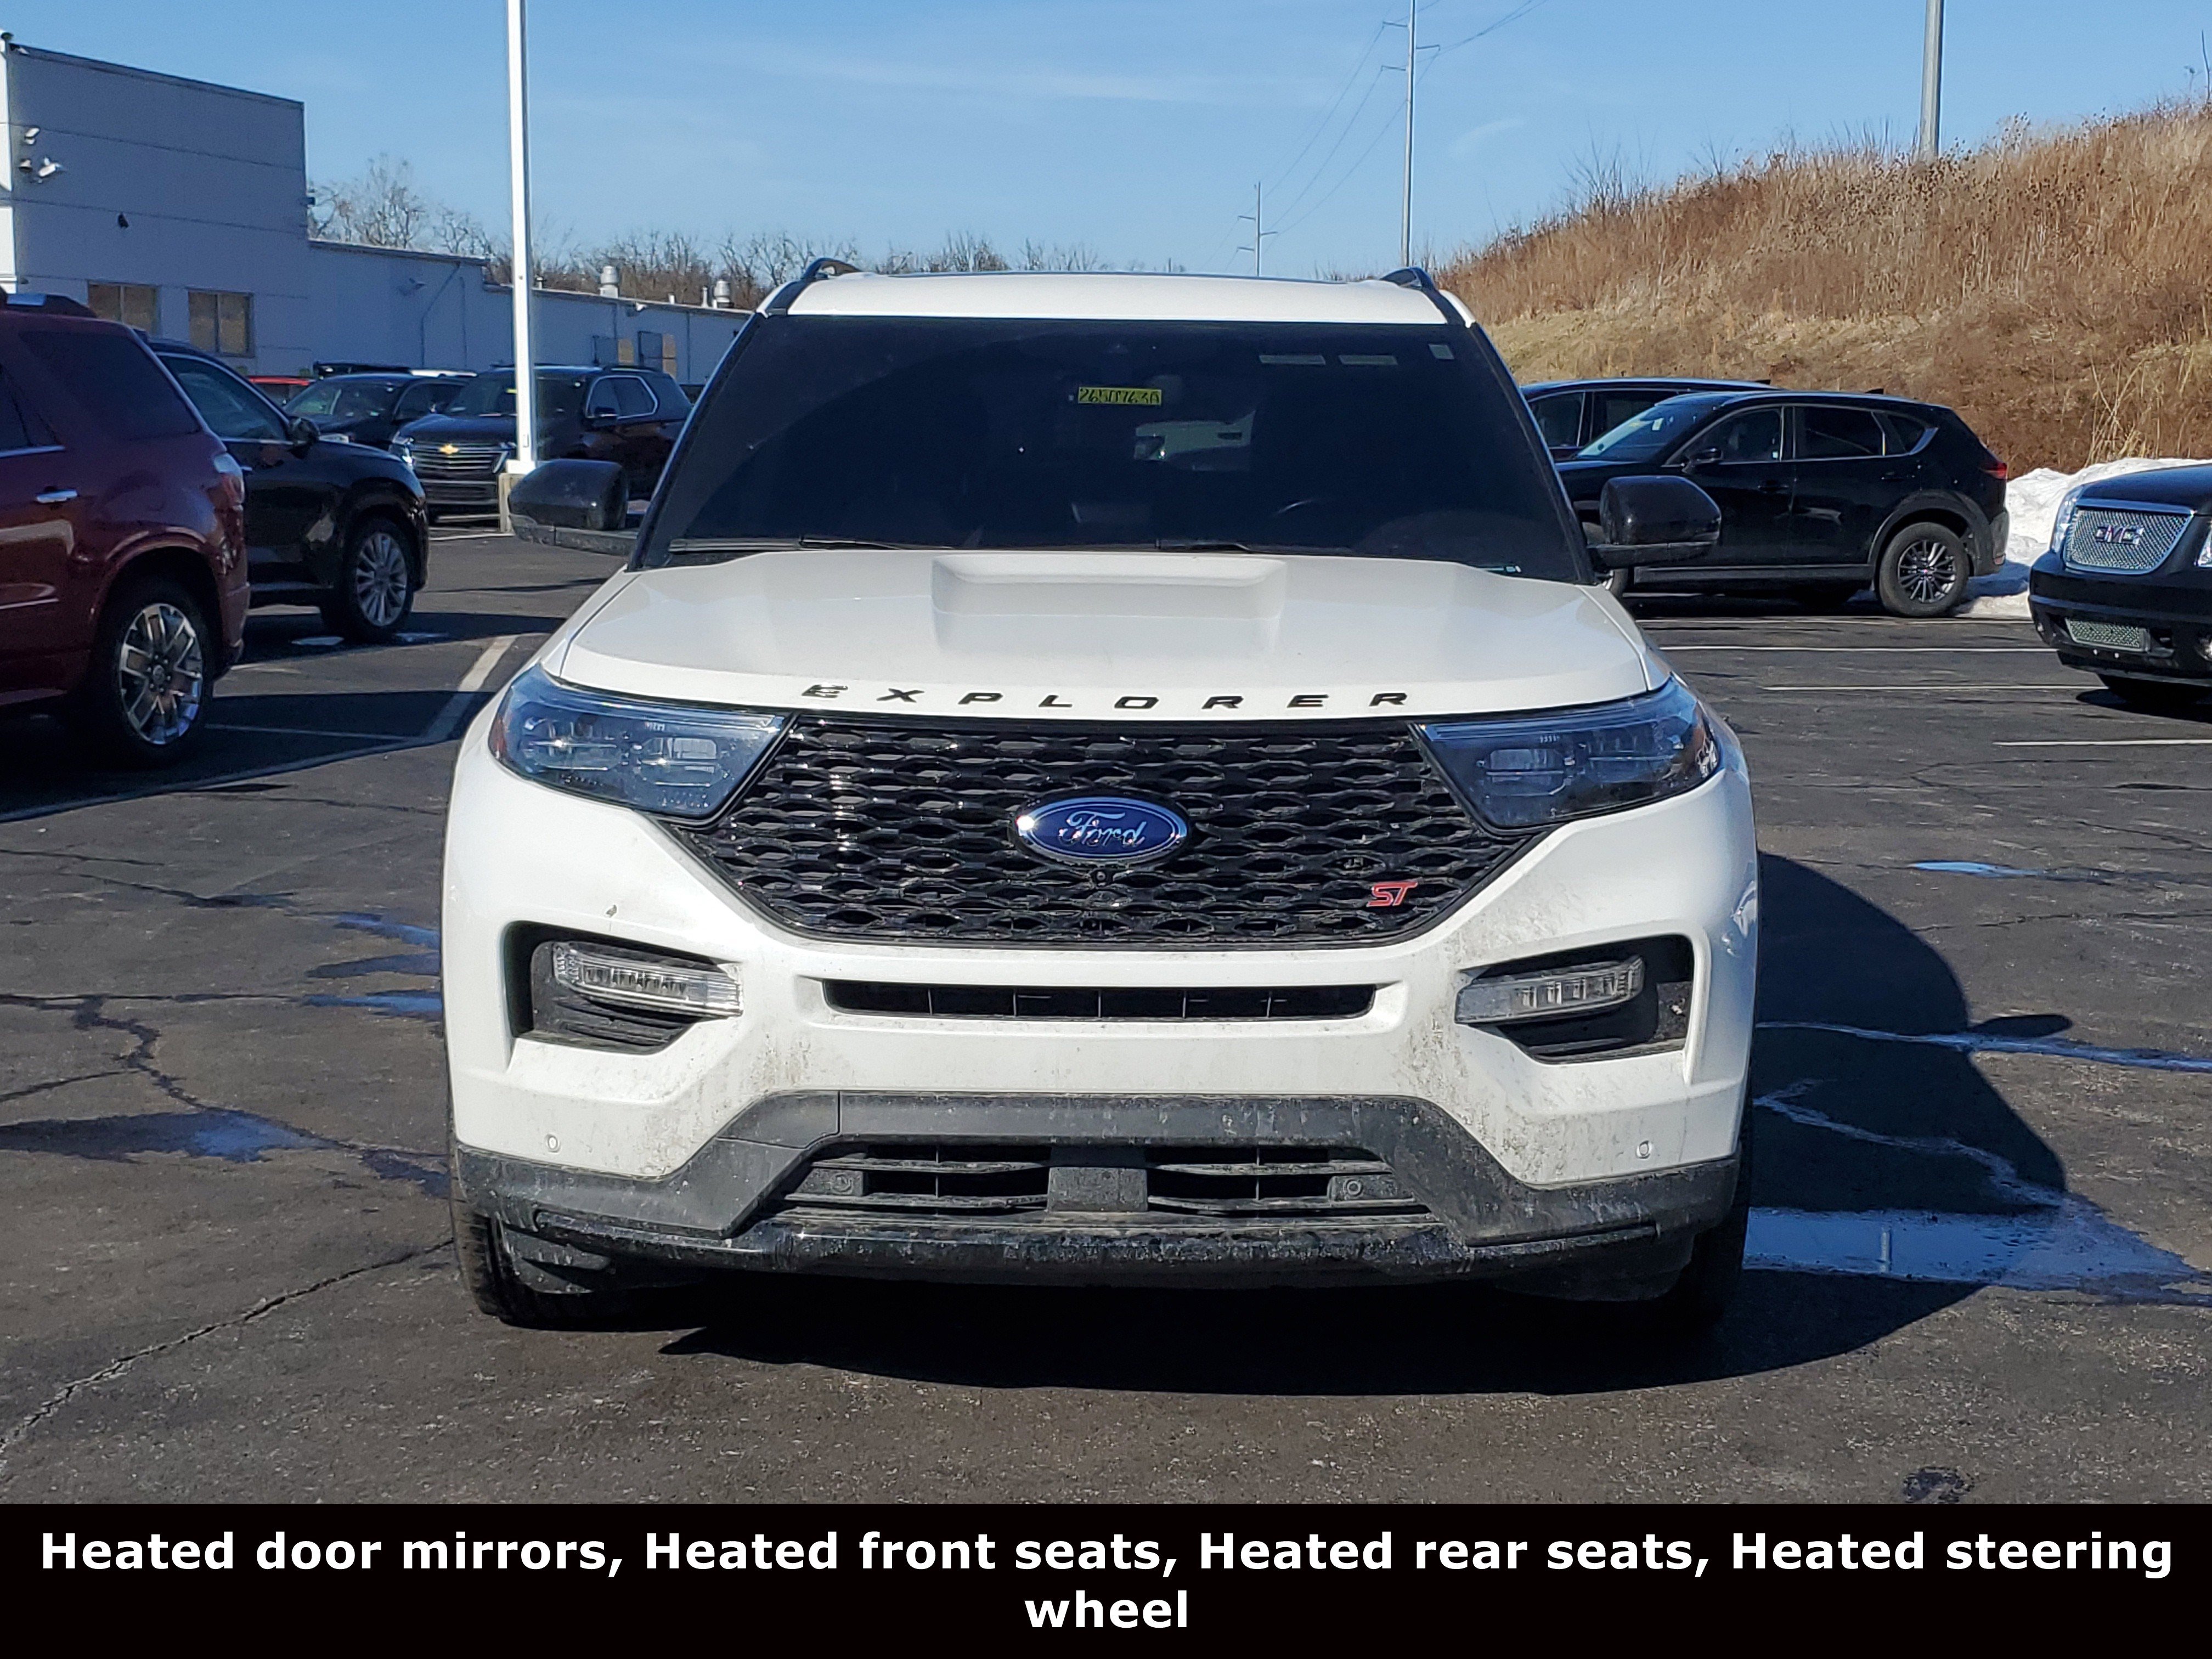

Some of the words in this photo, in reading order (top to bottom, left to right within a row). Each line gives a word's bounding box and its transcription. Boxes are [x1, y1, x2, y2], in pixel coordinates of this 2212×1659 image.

[802, 684, 1408, 710] EXPLORER
[1059, 811, 1147, 848] Ford
[1366, 881, 1418, 906] ST
